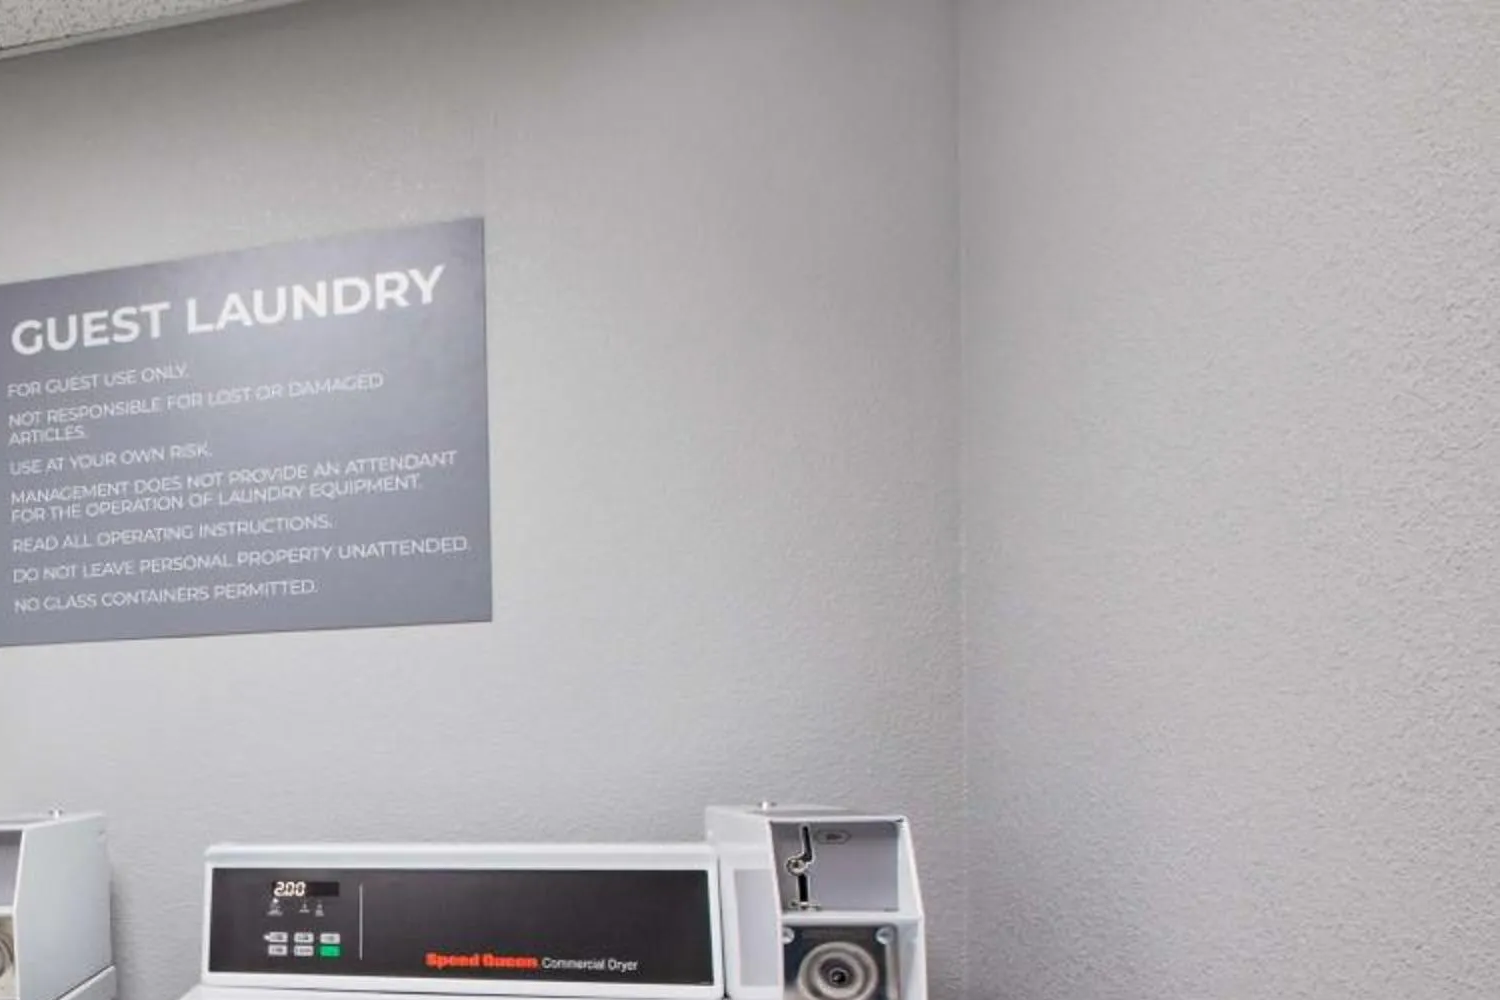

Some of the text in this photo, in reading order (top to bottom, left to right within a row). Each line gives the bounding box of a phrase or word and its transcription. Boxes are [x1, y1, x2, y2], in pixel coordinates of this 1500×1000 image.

[11, 263, 446, 355] GUEST LAUNDRY
[7, 381, 41, 398] FOR
[45, 374, 100, 394] GUEST
[103, 370, 136, 387] USE
[9, 372, 384, 427] NOT RESPONSIBLE FOR LOST OR DAMAGED
[9, 459, 42, 476] USE
[46, 457, 64, 473] AT
[70, 452, 116, 470] YOUR
[120, 446, 164, 465] OWN
[11, 450, 457, 505] MANAGEMENT DOES NOT PROVIDE AN ATTENDANT
[11, 507, 45, 523] FOR
[51, 503, 81, 520] THE
[85, 495, 183, 518] OPERATION
[188, 492, 213, 508] OF
[219, 484, 302, 506] LAUNDRY
[12, 536, 58, 553] READ
[62, 533, 92, 550] ALL
[97, 525, 194, 547] OPERATING
[12, 568, 38, 584] DO
[44, 564, 76, 580] NOT
[83, 560, 135, 579] LEAVE
[140, 553, 232, 574] PERSONAL
[237, 546, 332, 566] PROPERTY
[14, 597, 39, 613] NO
[43, 593, 97, 611] GLASS
[101, 585, 209, 607] CONTAINERS
[425, 952, 638, 972] Speed Queen Commercial Dryer
